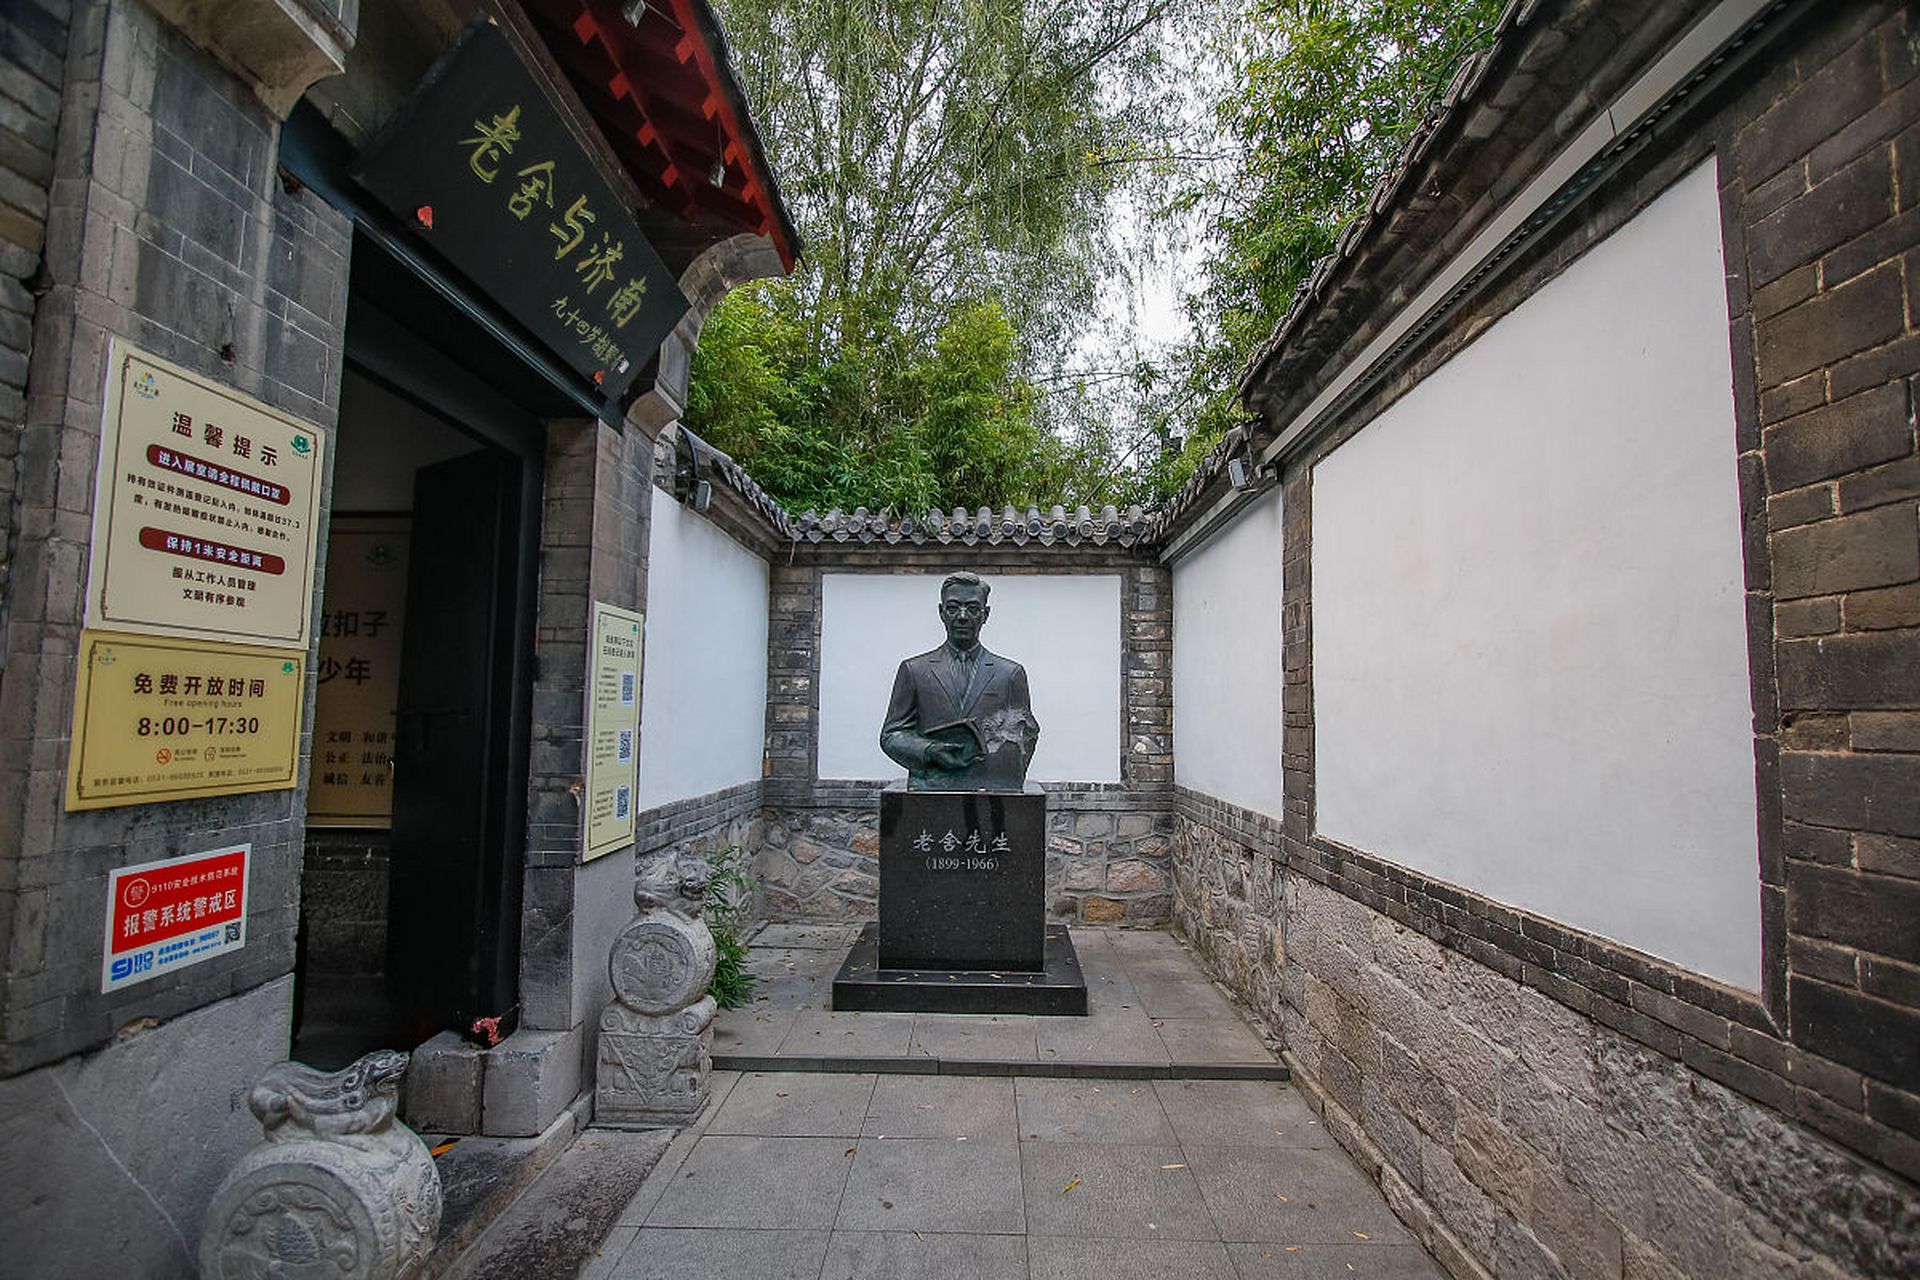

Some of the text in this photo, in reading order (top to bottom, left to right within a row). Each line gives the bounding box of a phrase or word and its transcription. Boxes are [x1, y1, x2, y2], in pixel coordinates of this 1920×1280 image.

[457, 104, 649, 328] 老舍与济南
[171, 411, 279, 466] 温馨提示
[166, 535, 263, 568] 保持1米安全距离
[171, 566, 257, 592] 服从工作人员管理
[182, 588, 246, 609] 文明有序参观
[133, 672, 266, 698] 免费开放时间
[316, 656, 373, 686] 少年
[164, 698, 183, 707] Free
[911, 829, 1012, 854] 老舍先生
[123, 889, 237, 938] 报警系统警戒区
